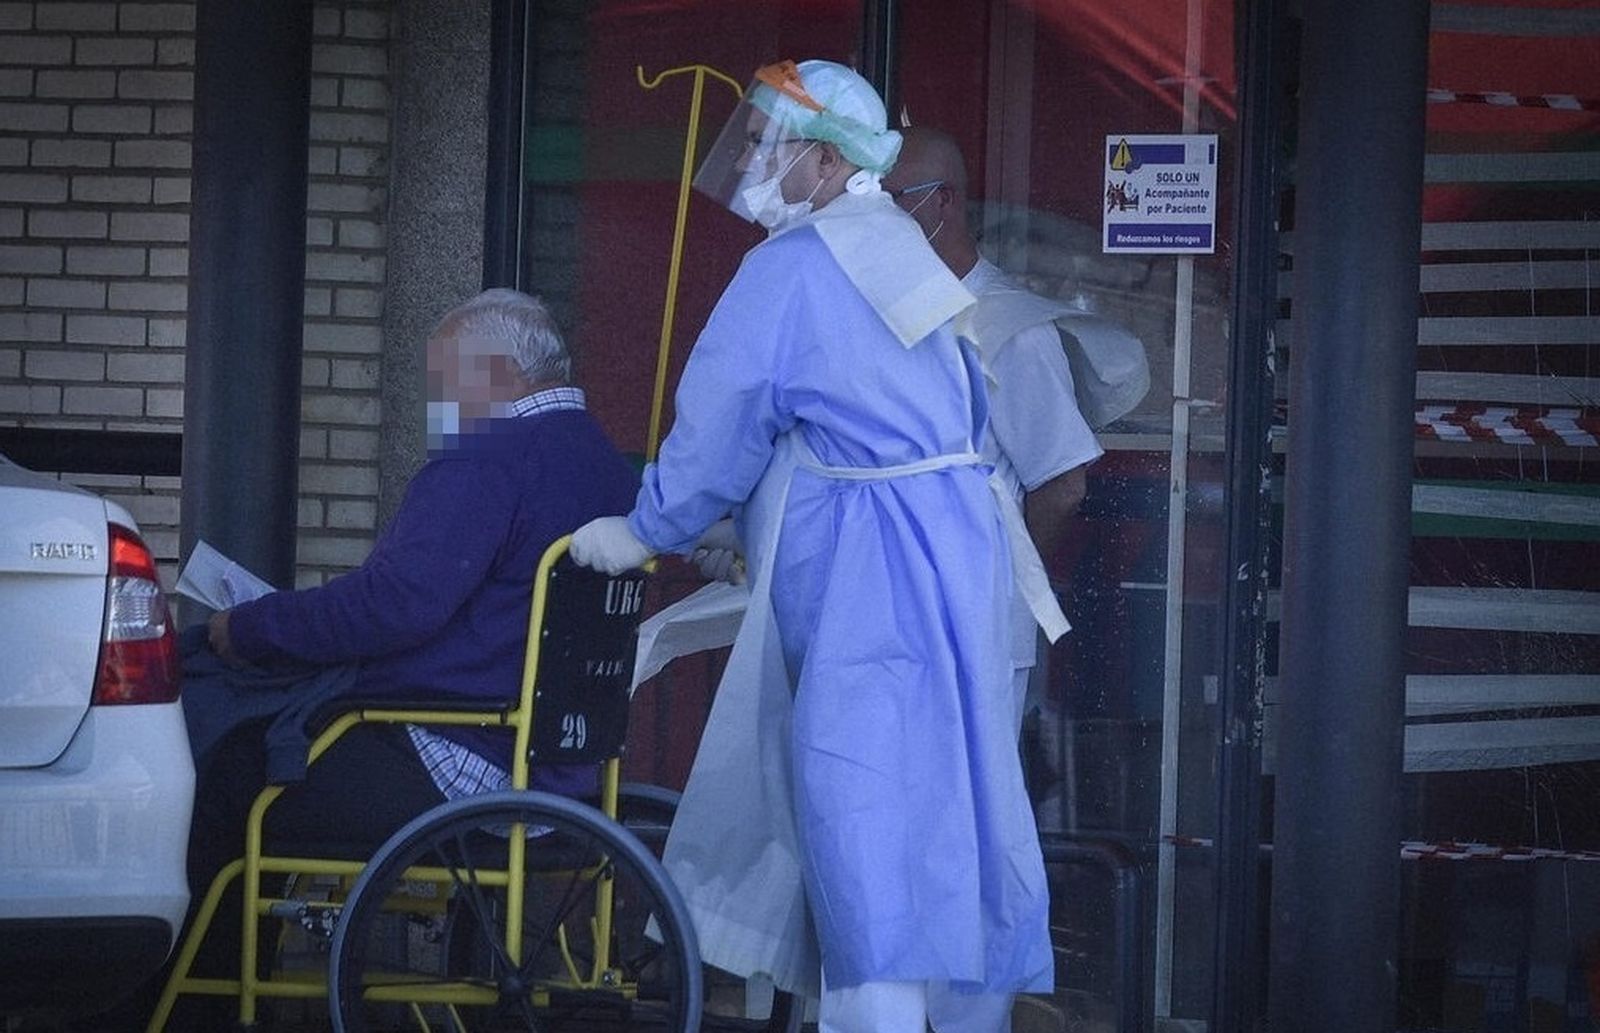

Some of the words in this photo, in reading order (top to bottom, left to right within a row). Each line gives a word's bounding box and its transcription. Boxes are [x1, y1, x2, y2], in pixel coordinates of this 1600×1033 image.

[1156, 172, 1182, 183] SOLO
[1185, 172, 1200, 183] UN
[1144, 188, 1210, 201] Acompañante
[1147, 205, 1163, 216] por
[1165, 203, 1207, 214] Paciente
[1162, 234, 1174, 244] los
[560, 713, 587, 750] 29
